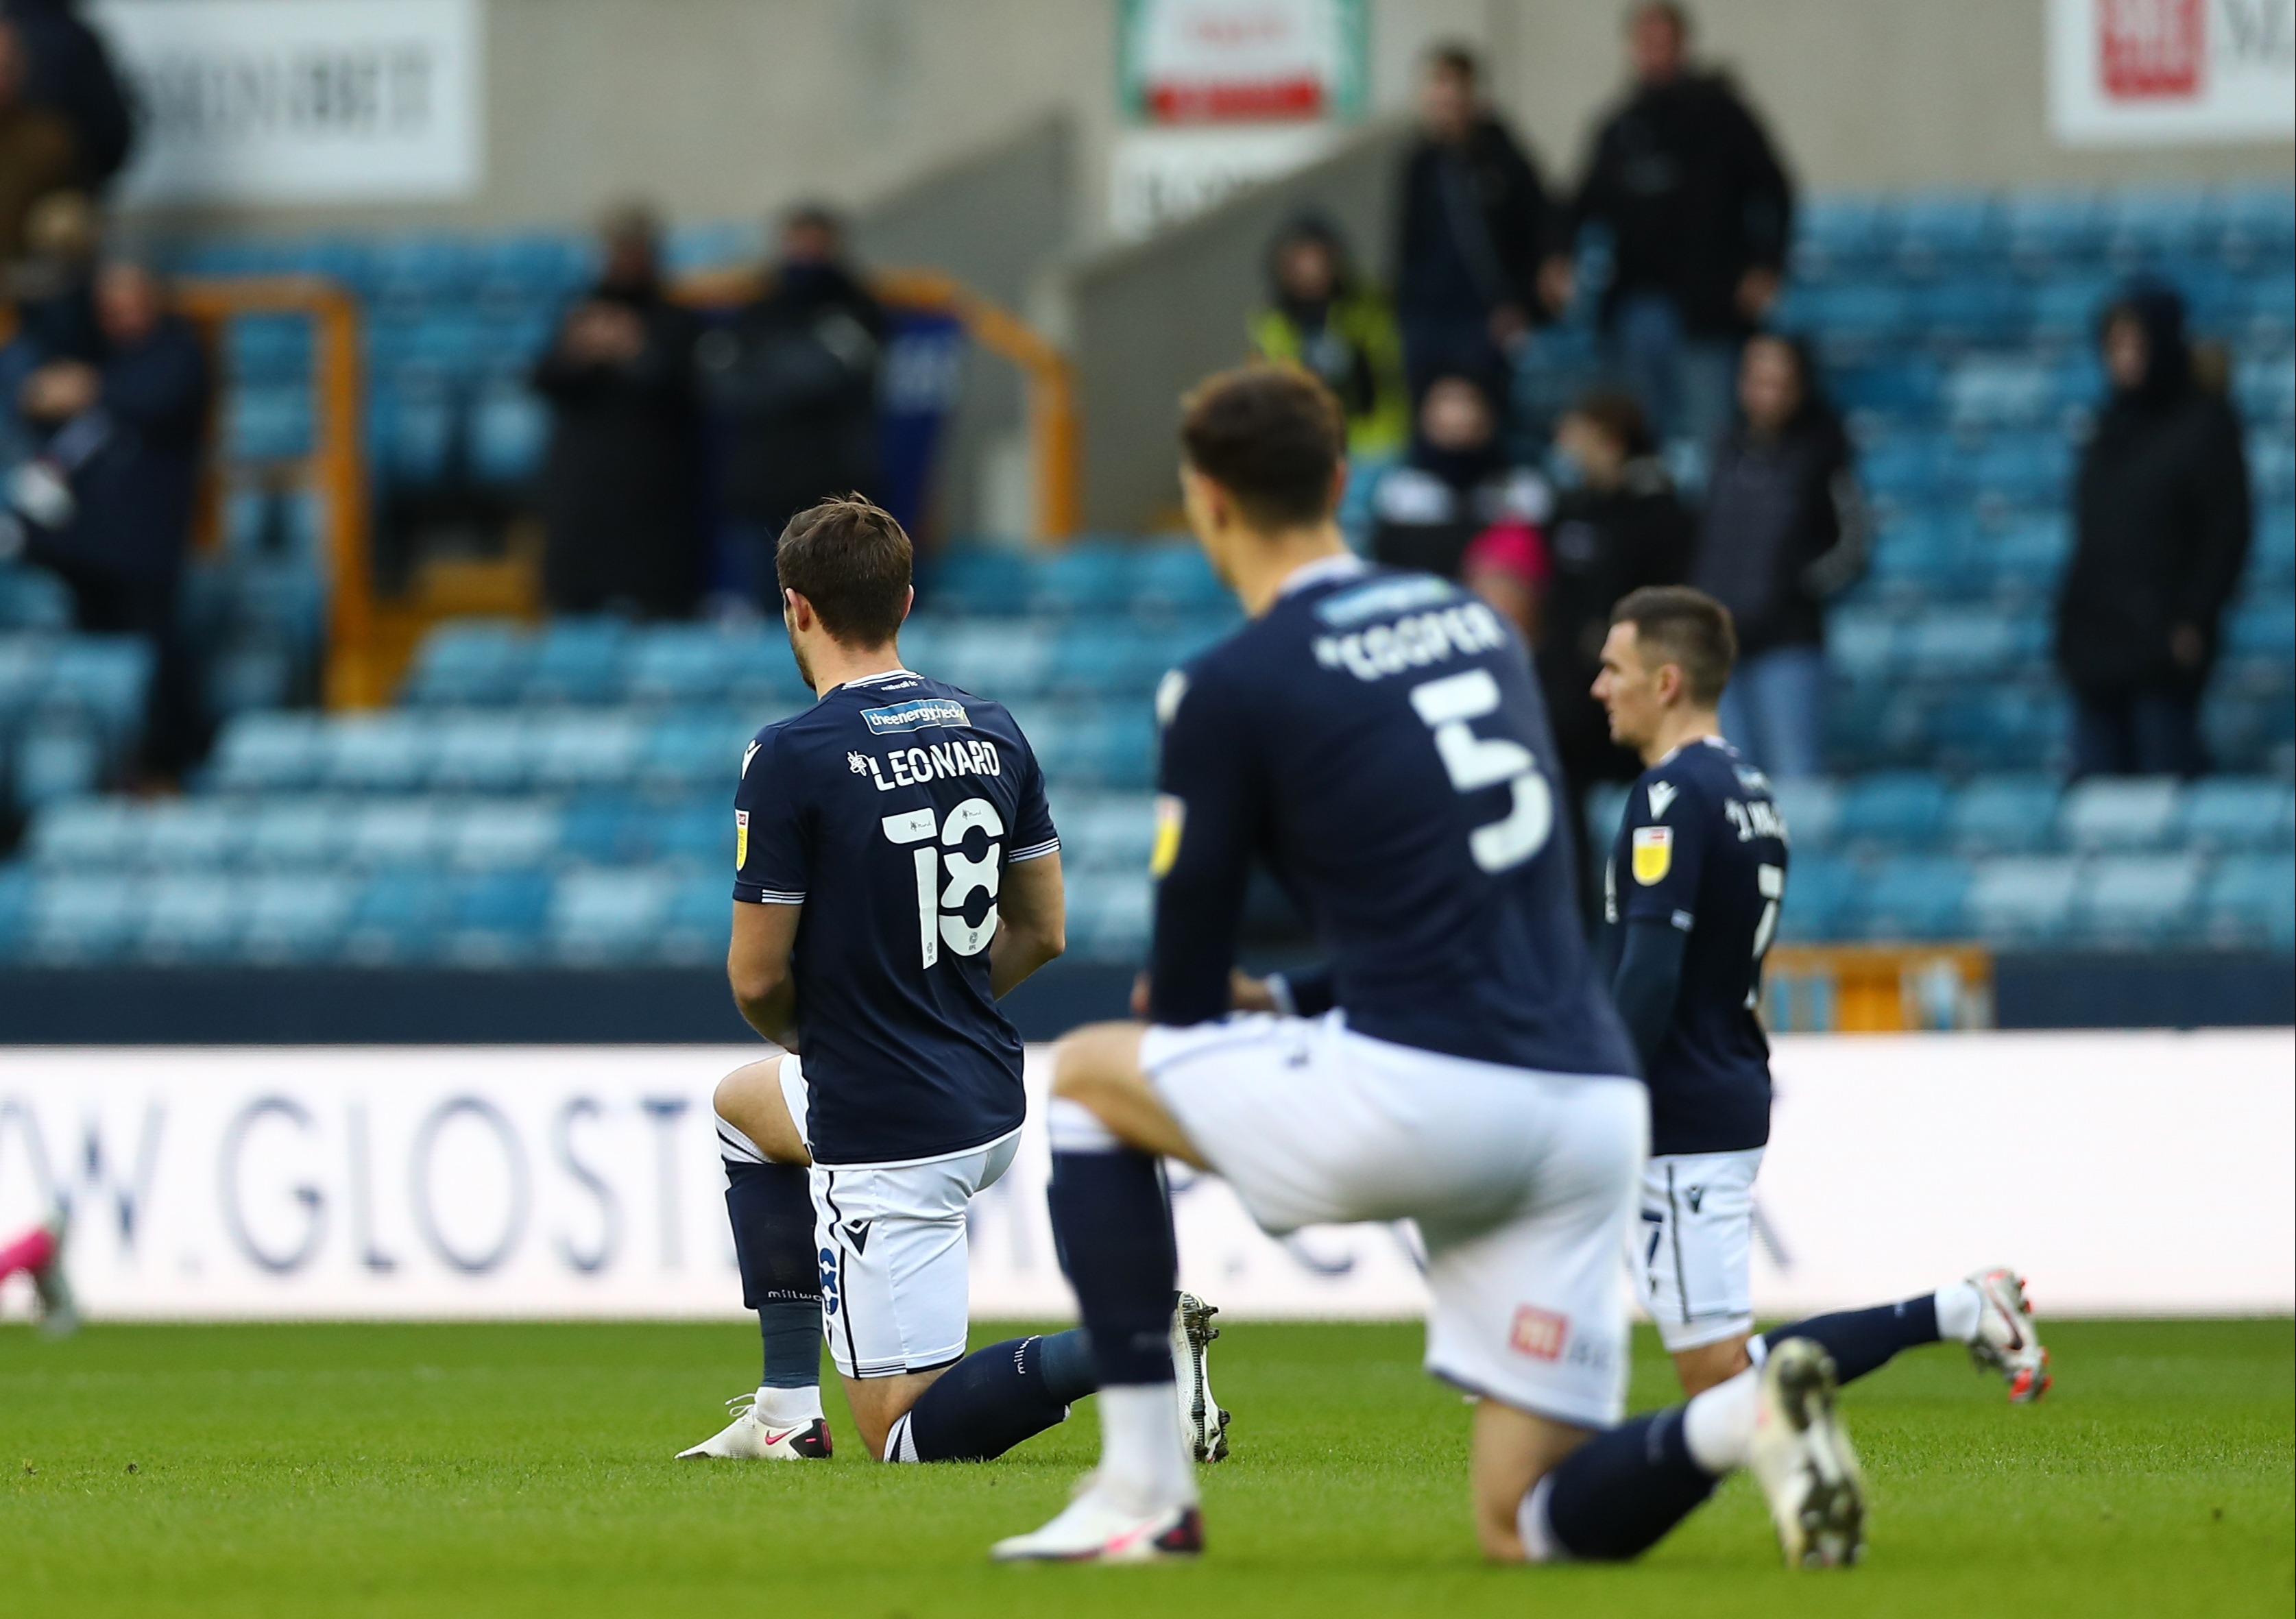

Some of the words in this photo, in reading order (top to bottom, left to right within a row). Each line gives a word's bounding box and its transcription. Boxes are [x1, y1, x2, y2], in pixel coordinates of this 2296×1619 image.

[1340, 603, 1506, 681] COOPER
[867, 740, 1000, 791] LEONARD
[1410, 668, 1554, 875] 5
[882, 798, 1004, 970] 18
[768, 1289, 822, 1302] millwa
